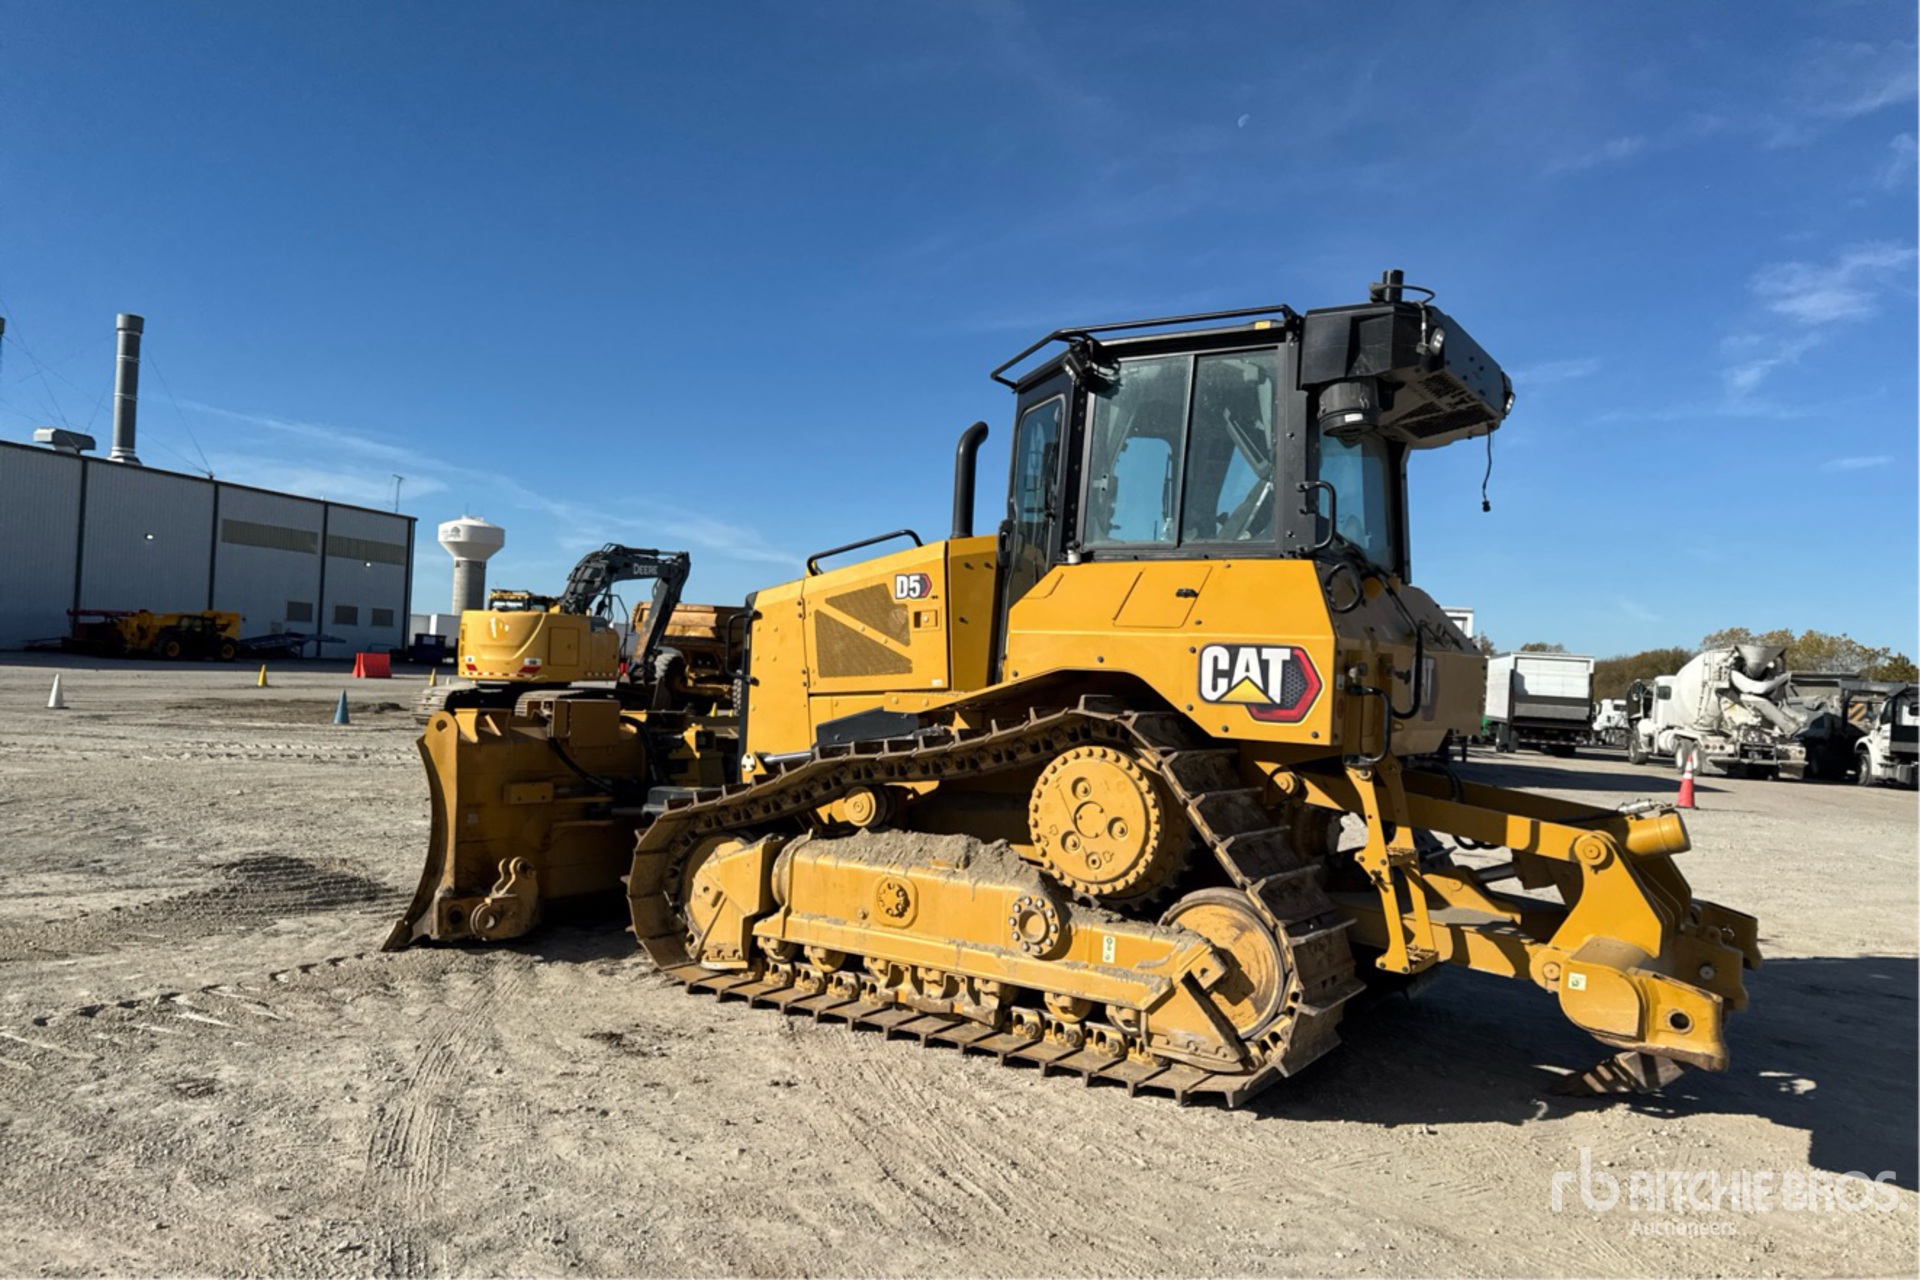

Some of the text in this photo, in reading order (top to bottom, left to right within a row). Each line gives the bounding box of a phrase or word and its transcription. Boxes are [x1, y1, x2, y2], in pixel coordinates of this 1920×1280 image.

[633, 562, 658, 576] DEERE
[896, 575, 921, 599] D5
[1200, 645, 1291, 705] CAT
